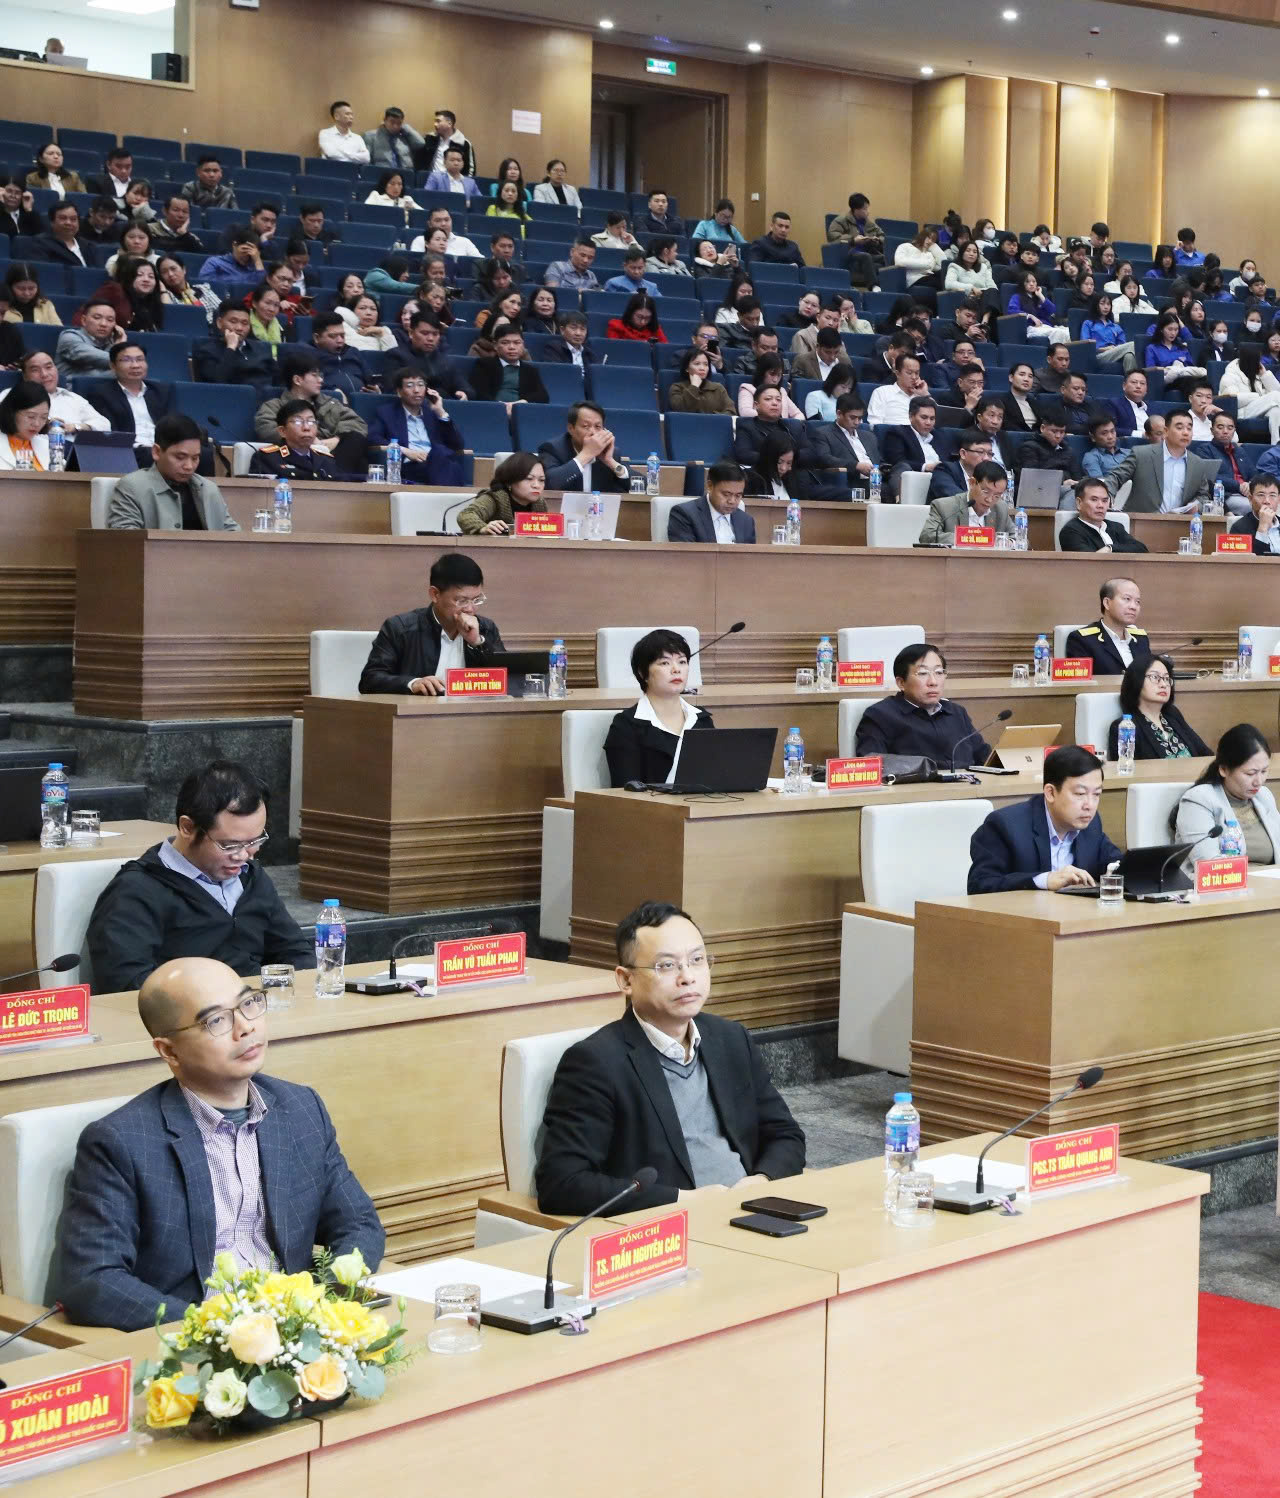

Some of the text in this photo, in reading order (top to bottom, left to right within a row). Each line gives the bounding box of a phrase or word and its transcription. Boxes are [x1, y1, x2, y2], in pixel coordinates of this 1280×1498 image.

[463, 940, 499, 952] ĐỒNG CHÍ
[443, 955, 464, 972] TRẦN
[465, 954, 475, 969] VŨ
[497, 951, 519, 965] PHAN
[6, 994, 56, 1008] ĐỒNG CHÍ
[2, 1006, 79, 1029] LÊ ĐỨC TRỌNG
[1056, 1136, 1092, 1150] ĐỒNG CHÍ
[1076, 1150, 1098, 1168] QUANG
[1098, 1146, 1113, 1162] ANH
[619, 1224, 660, 1246] ĐỒNG CHÍ
[596, 1258, 609, 1276] TS.
[610, 1247, 632, 1272] TRẦN
[664, 1233, 681, 1253] CÁC
[11, 1380, 82, 1410] ĐỒNG CHÍ
[10, 1408, 62, 1441] XUÂN
[66, 1394, 110, 1425] HOÀI
